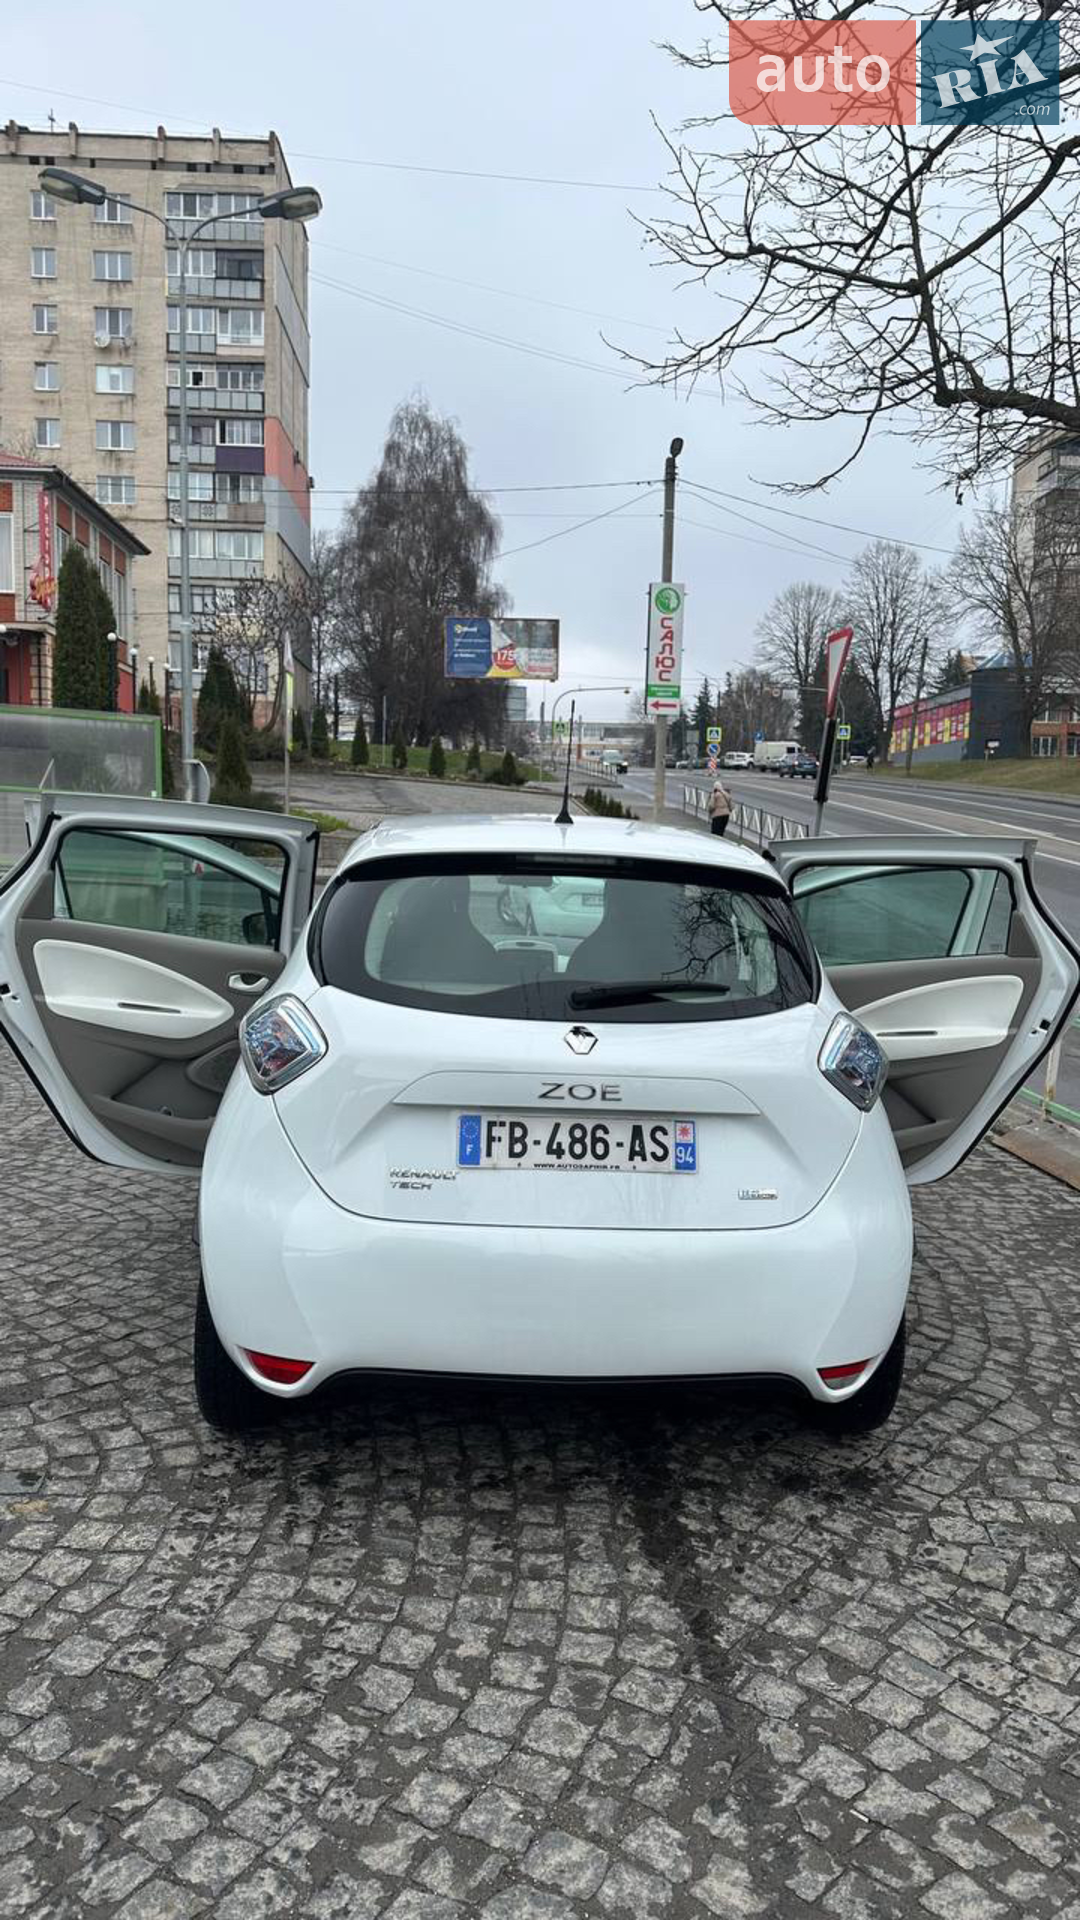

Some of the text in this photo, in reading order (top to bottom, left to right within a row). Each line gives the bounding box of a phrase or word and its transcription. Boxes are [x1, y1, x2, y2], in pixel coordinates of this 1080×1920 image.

[655, 617, 676, 682] САЛЮС
[537, 1082, 623, 1102] ZOE
[485, 1120, 670, 1163] FB-486-AS
[676, 1146, 694, 1164] 94
[389, 1168, 457, 1180] RENAULT
[389, 1181, 433, 1190] TECH
